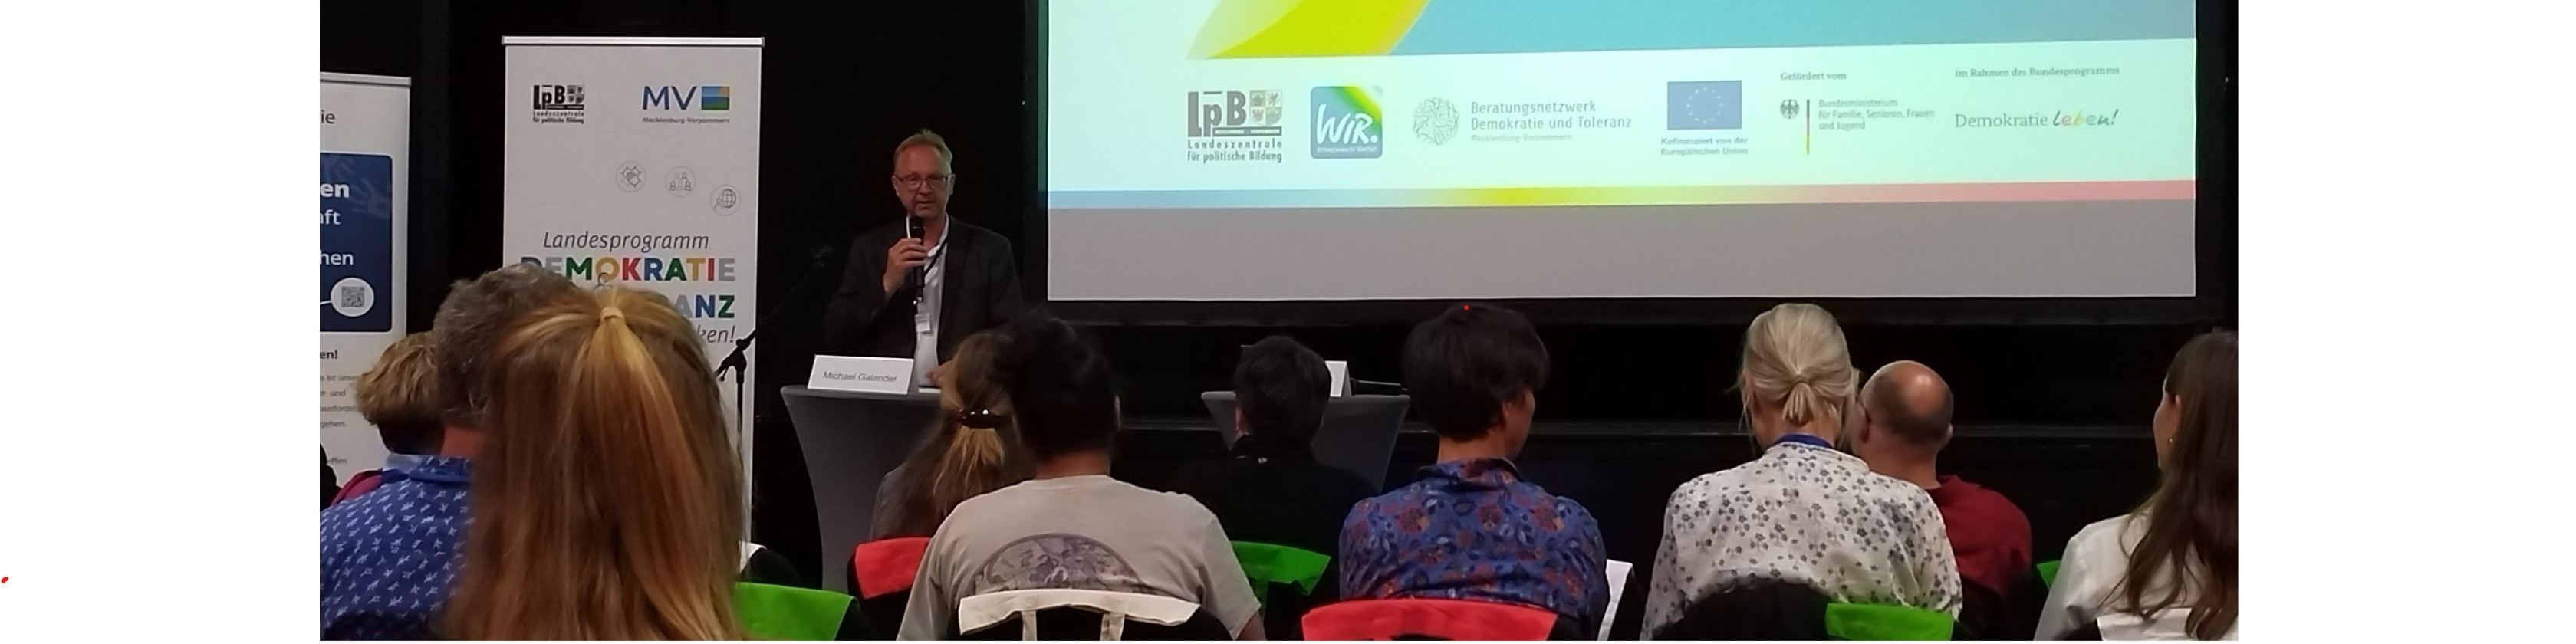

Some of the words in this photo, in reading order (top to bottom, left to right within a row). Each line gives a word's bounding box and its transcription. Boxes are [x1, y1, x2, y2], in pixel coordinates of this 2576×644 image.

[1780, 71, 1824, 80] Gefördert
[1956, 68, 1968, 77] im
[1971, 67, 2009, 77] Rahmen
[2012, 67, 2027, 76] des
[2029, 66, 2120, 77] Bundesprogramms
[643, 86, 697, 110] MV
[1819, 98, 1898, 108] Bundesministerium
[1188, 90, 1246, 136] LpB
[1471, 100, 1596, 116] Beratungsnetzwerk
[1819, 110, 1831, 119] für
[1907, 108, 1935, 118] Frauen
[1472, 117, 1545, 130] Demokratie
[1549, 117, 1573, 129] und
[1578, 116, 1632, 129] Toleranz
[1819, 121, 1834, 130] und
[1837, 121, 1865, 131] Jugend
[1955, 113, 2048, 128] Demokratie
[1187, 138, 1282, 149] Landeszentrale
[1661, 137, 1713, 146] Kofinanziert
[1188, 150, 1201, 161] für
[1202, 150, 1246, 164] politische
[1249, 150, 1282, 163] Bildung
[1661, 148, 1721, 156] Europäischen
[1722, 147, 1749, 156] Union
[544, 231, 709, 253] Landesprogramm
[823, 371, 856, 381] Michael
